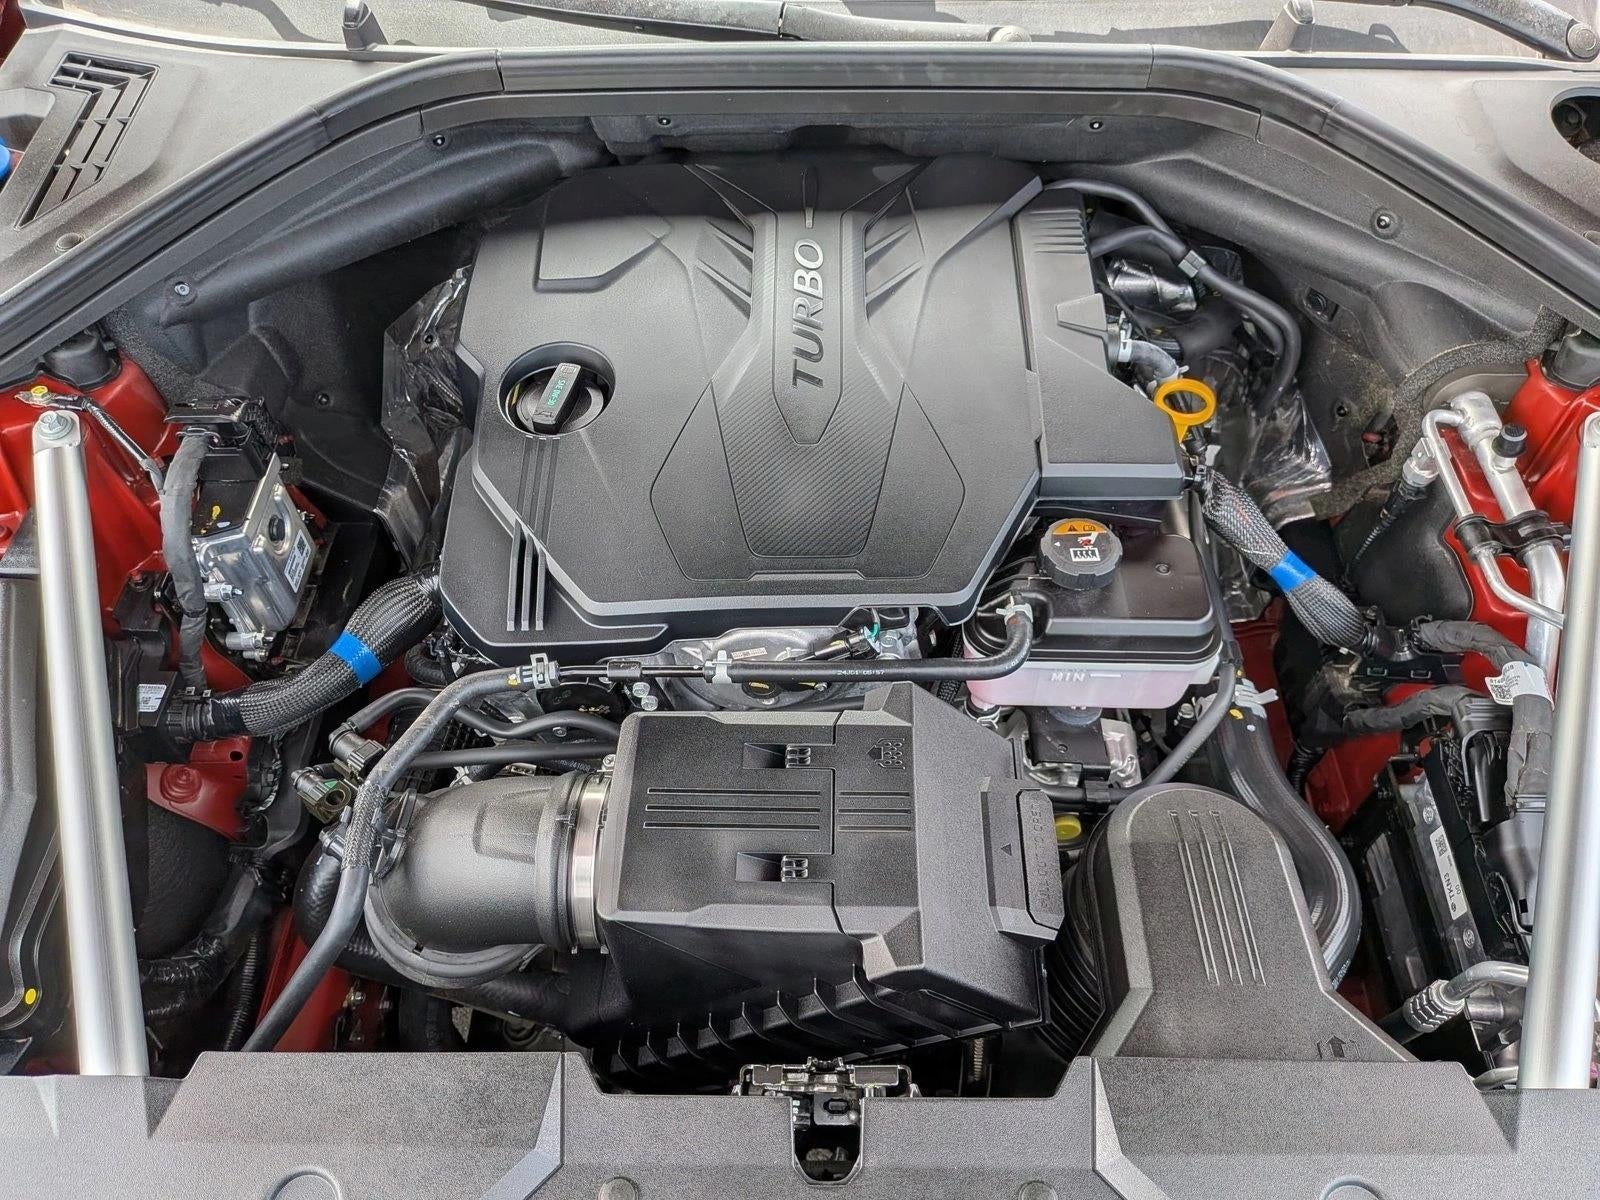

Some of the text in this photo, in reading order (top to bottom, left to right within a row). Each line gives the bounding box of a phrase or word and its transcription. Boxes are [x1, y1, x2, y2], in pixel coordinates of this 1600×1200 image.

[792, 238, 825, 388] TURBO
[1050, 671, 1085, 682] MIN
[1443, 872, 1455, 901] TKN3
